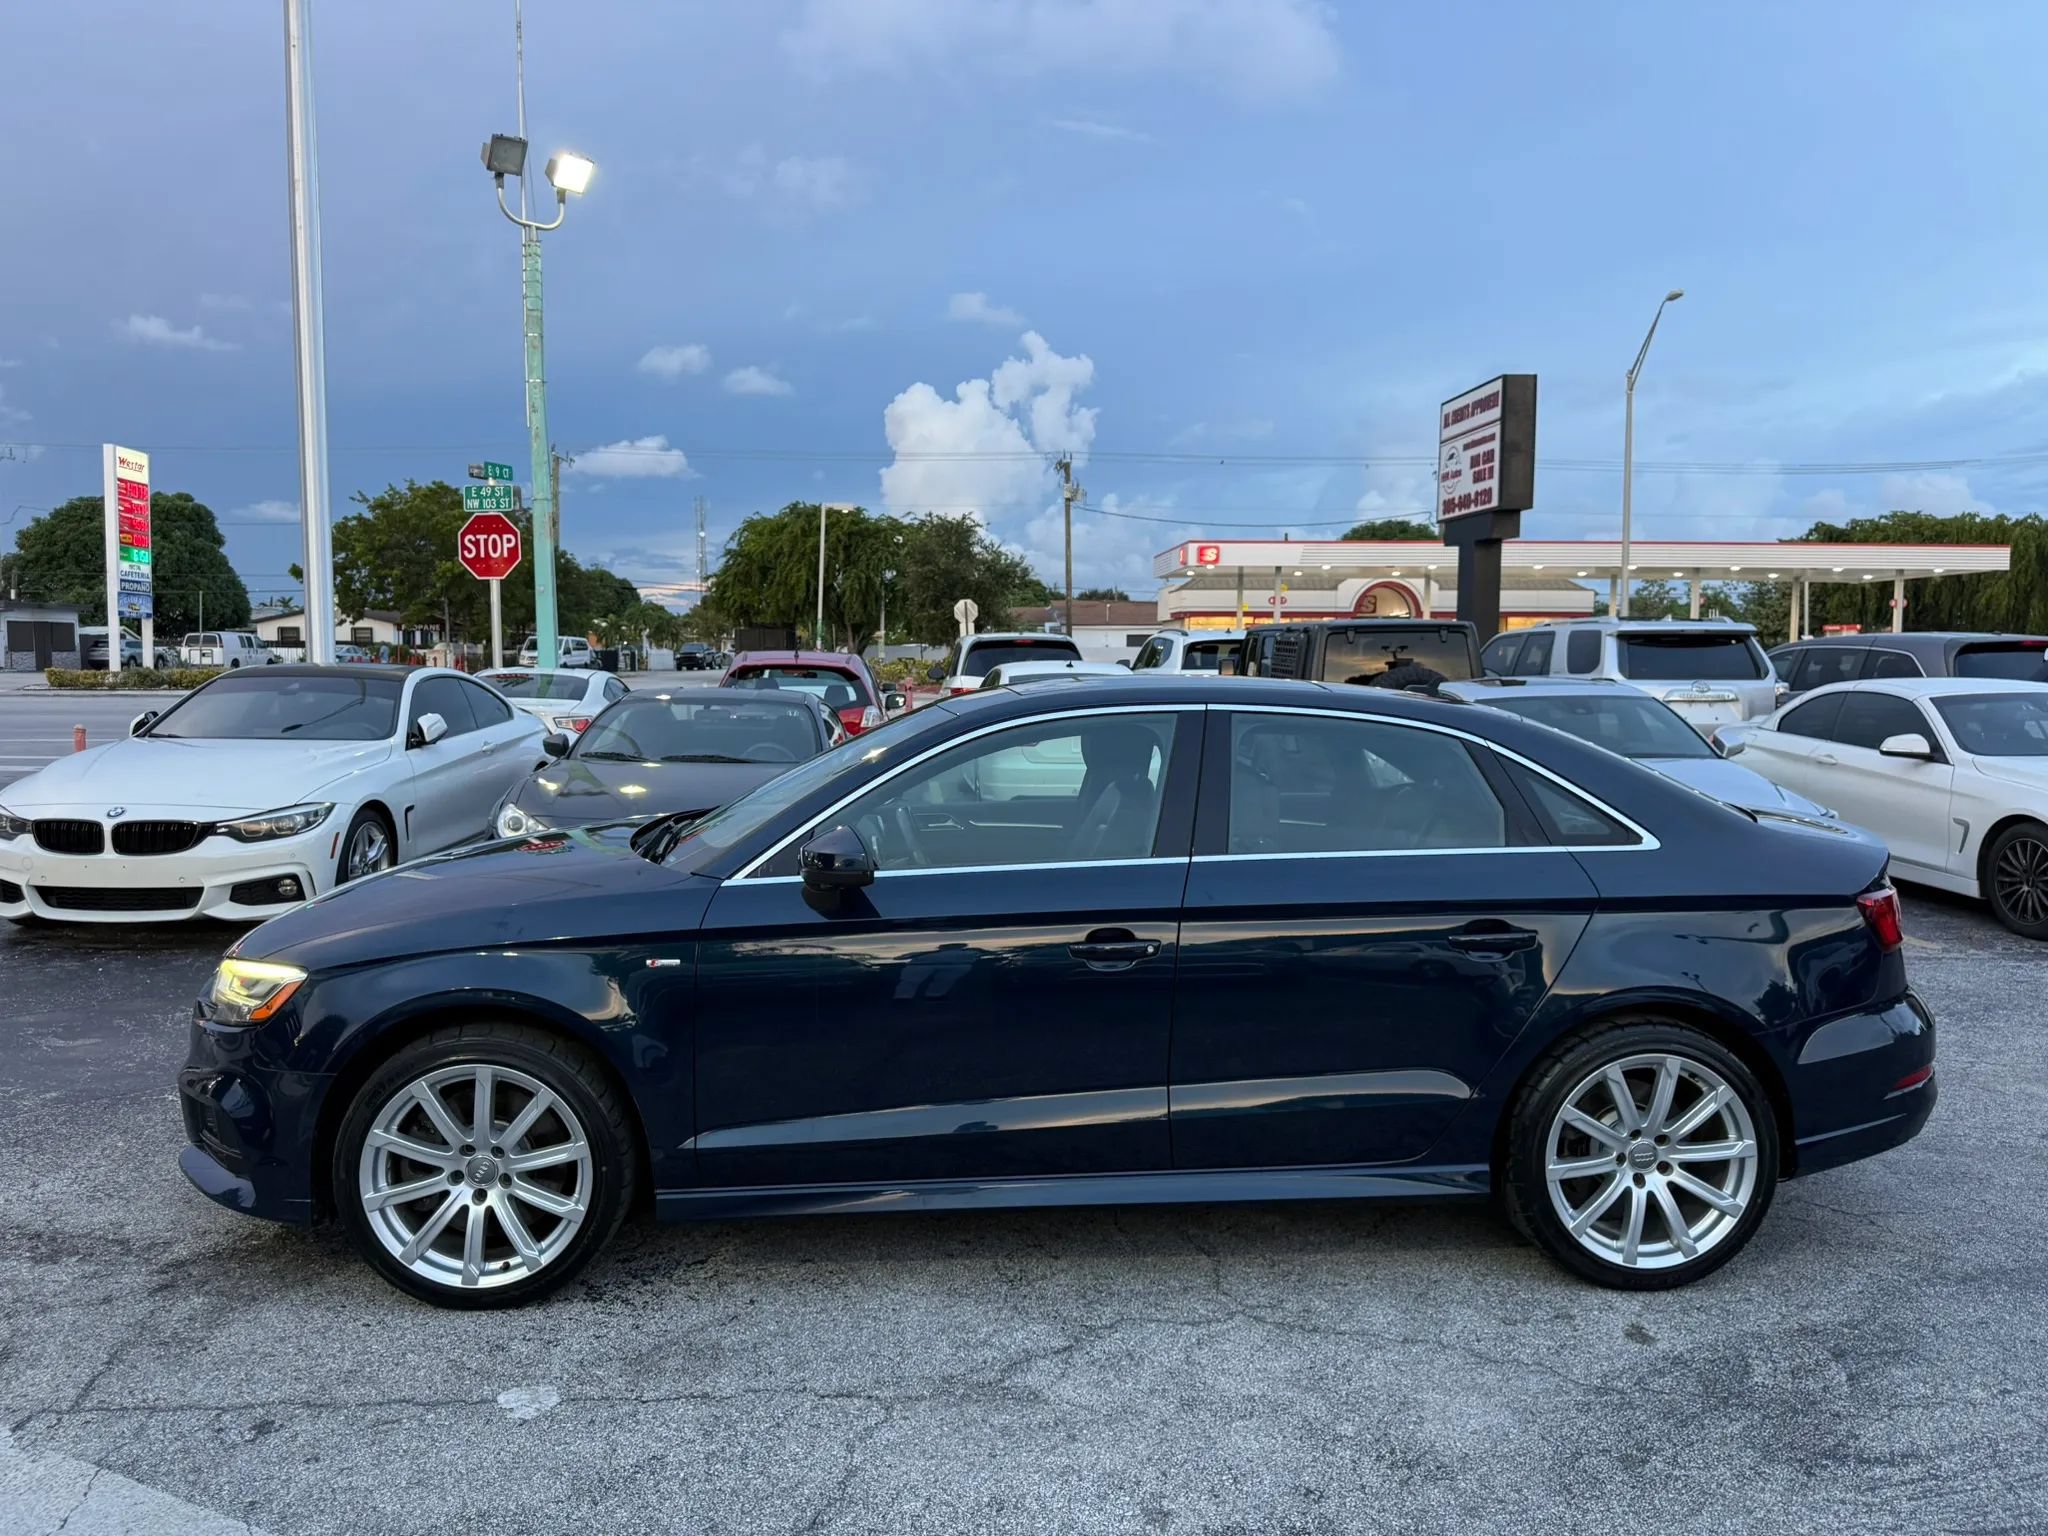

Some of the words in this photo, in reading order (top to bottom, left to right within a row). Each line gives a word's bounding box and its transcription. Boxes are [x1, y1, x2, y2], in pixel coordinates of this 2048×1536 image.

[118, 456, 145, 471] Westar
[488, 466, 493, 476] E
[495, 467, 500, 477] 9
[503, 468, 510, 478] CT
[1472, 467, 1487, 484] SALE
[472, 487, 477, 497] E
[480, 487, 491, 497] 49
[495, 487, 504, 497] ST
[467, 499, 480, 509] NW
[483, 499, 497, 509] 103
[500, 498, 509, 509] ST
[463, 534, 516, 558] STOP
[120, 570, 150, 580] CAFETERIA
